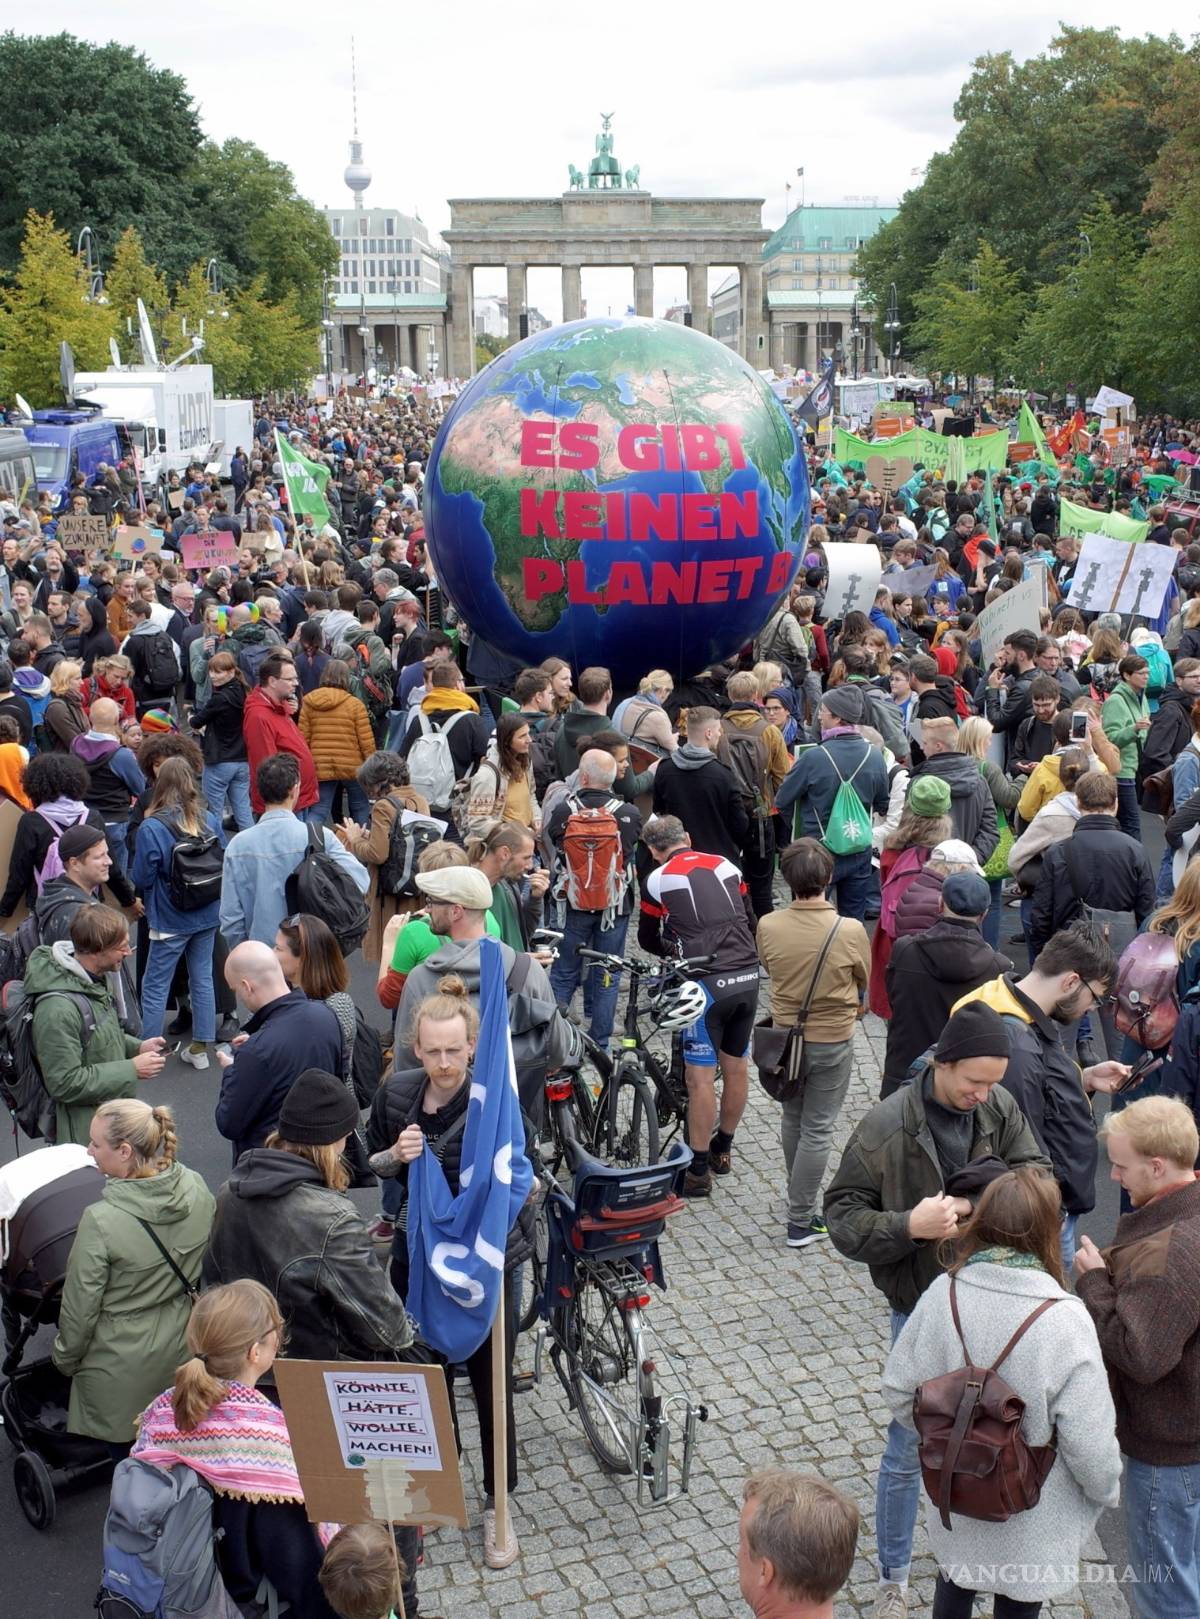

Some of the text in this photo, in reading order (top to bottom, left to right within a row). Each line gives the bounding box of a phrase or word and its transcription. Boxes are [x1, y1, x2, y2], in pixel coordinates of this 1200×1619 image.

[520, 420, 748, 472] ES GIBT
[63, 519, 105, 533] UNSERE
[520, 488, 759, 541] KEINEN
[64, 534, 106, 546] ZUKUNFT
[523, 551, 793, 605] PLANET B
[350, 1441, 432, 1455] MACHEN!
